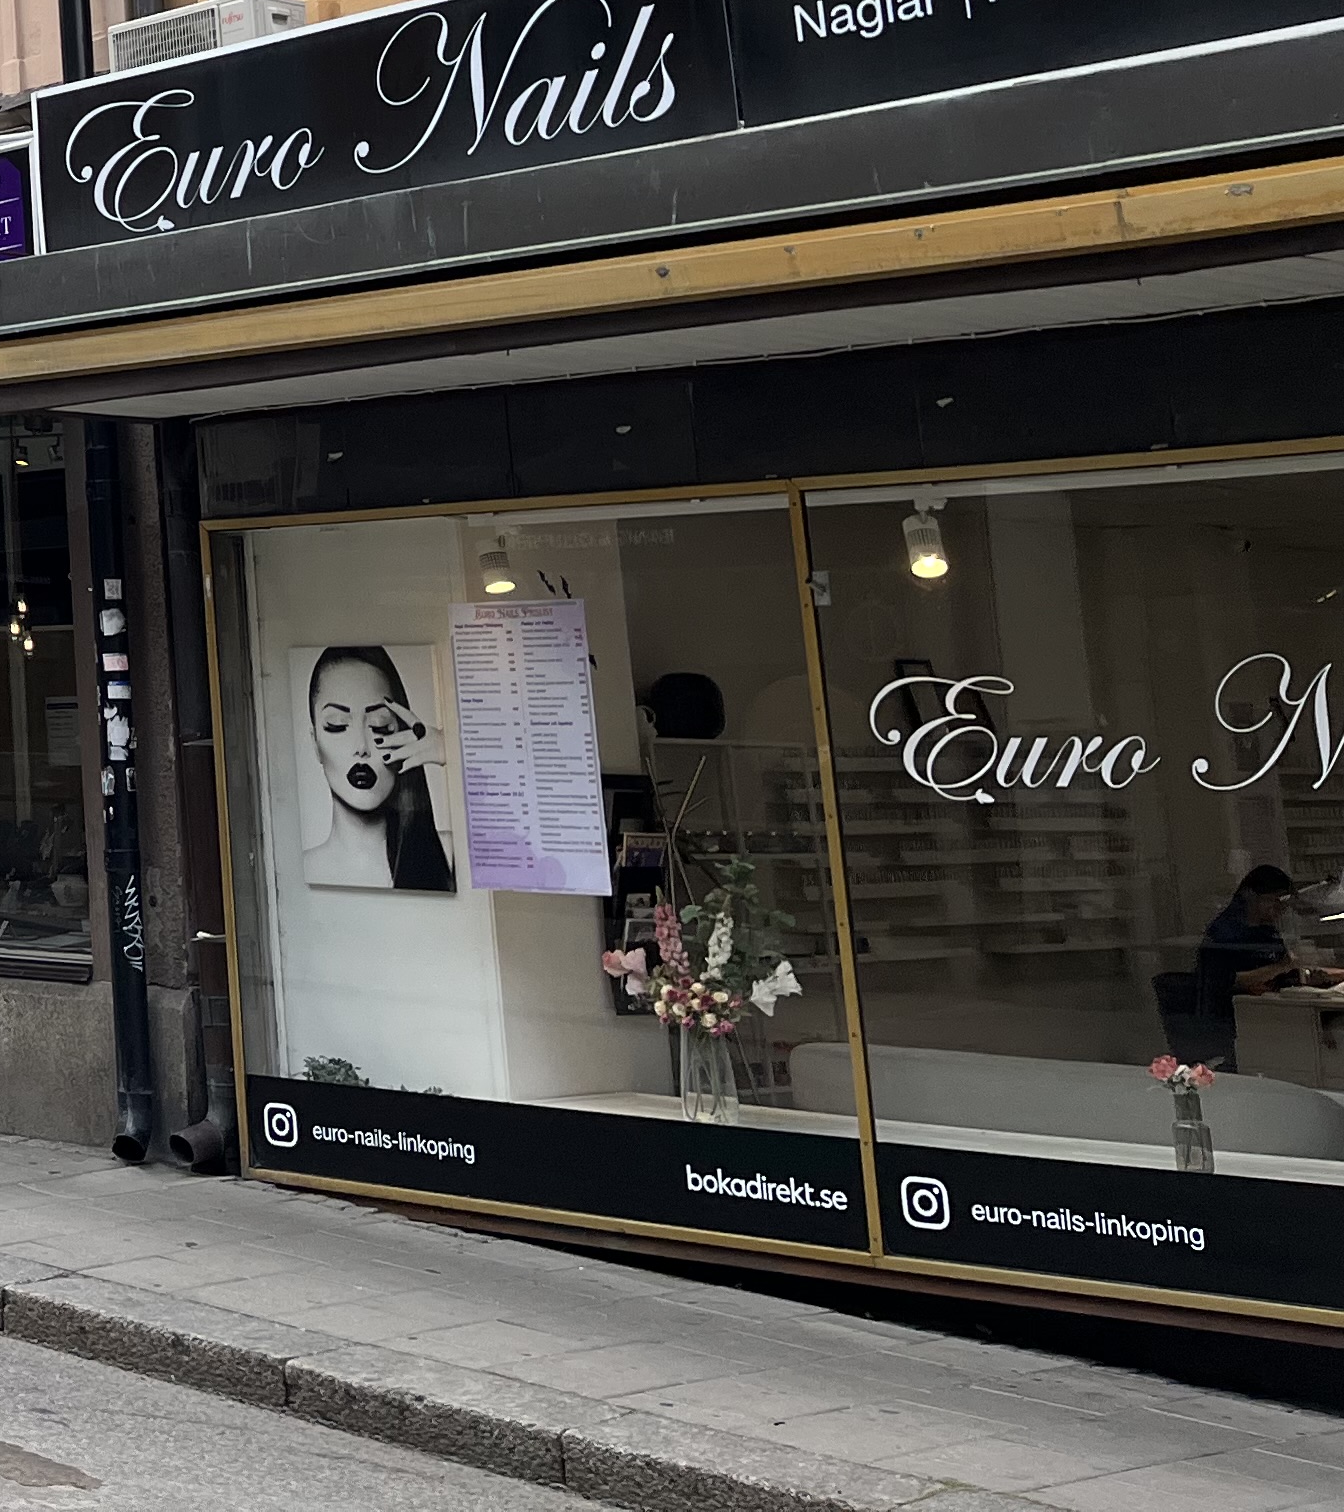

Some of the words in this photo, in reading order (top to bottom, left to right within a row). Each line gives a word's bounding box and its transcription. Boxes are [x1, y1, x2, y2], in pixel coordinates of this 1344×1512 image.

[66, 89, 324, 232] Euro
[869, 675, 1161, 804] Euro
[312, 1124, 476, 1165] euro-nails-linkoping
[685, 1164, 848, 1211] bokadirekt.se
[971, 1203, 1205, 1252] euro-nails-linkoping
